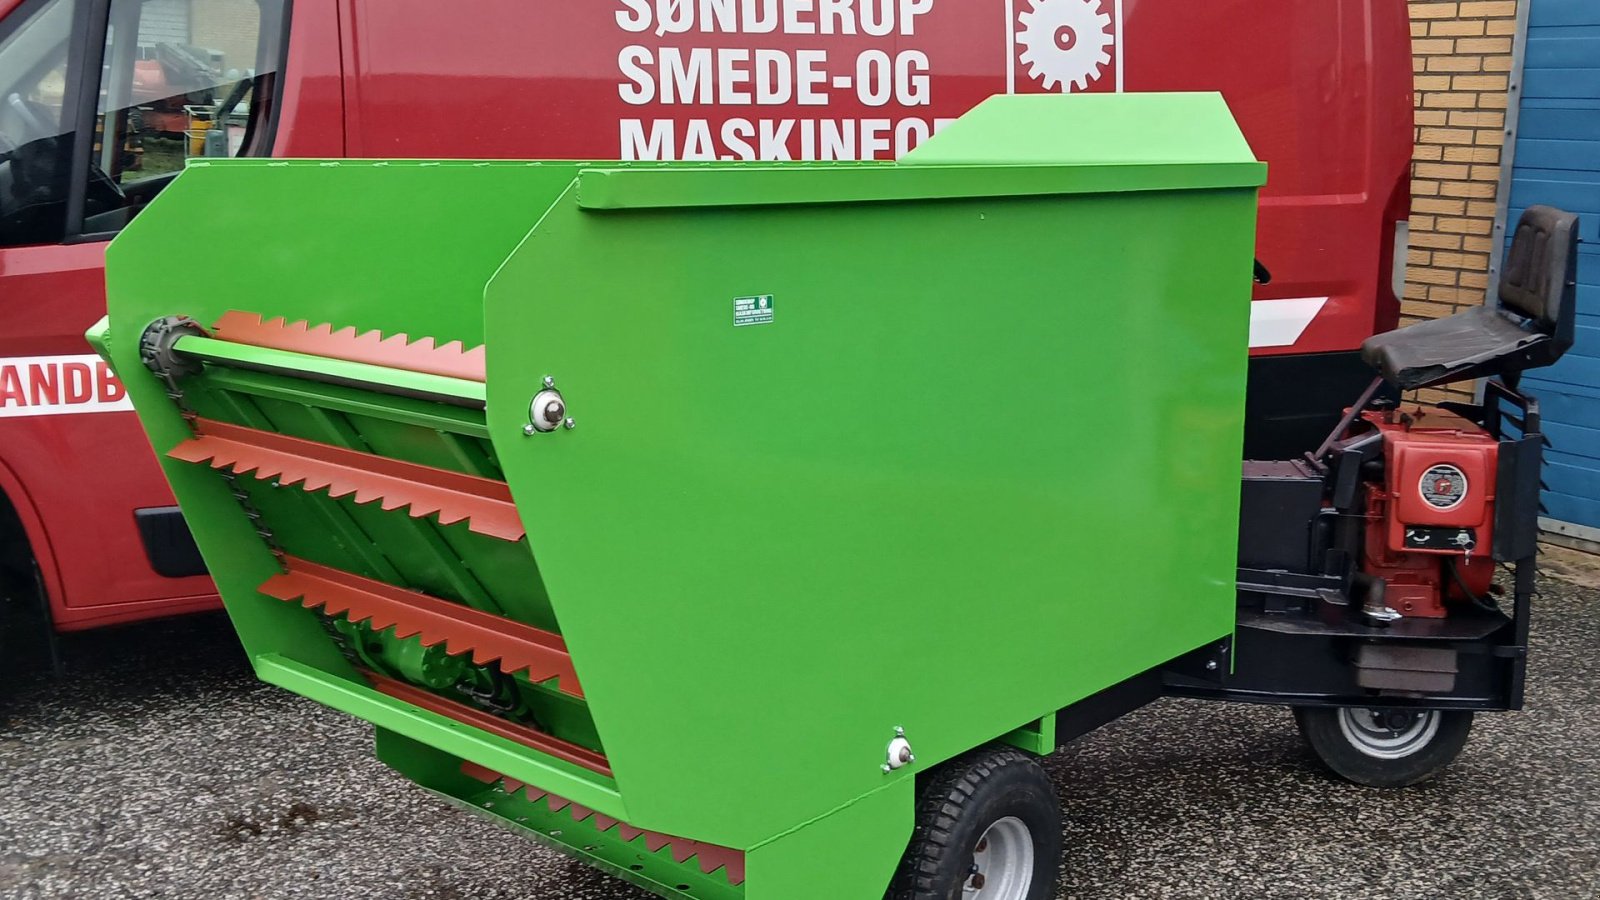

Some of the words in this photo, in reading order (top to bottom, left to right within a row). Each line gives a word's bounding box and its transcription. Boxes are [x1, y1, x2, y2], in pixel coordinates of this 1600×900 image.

[615, 0, 934, 37] SØNDERUP
[617, 45, 931, 106] SMEDE-OG
[619, 117, 959, 161] MASKINFO
[0, 361, 126, 408] ANDB
